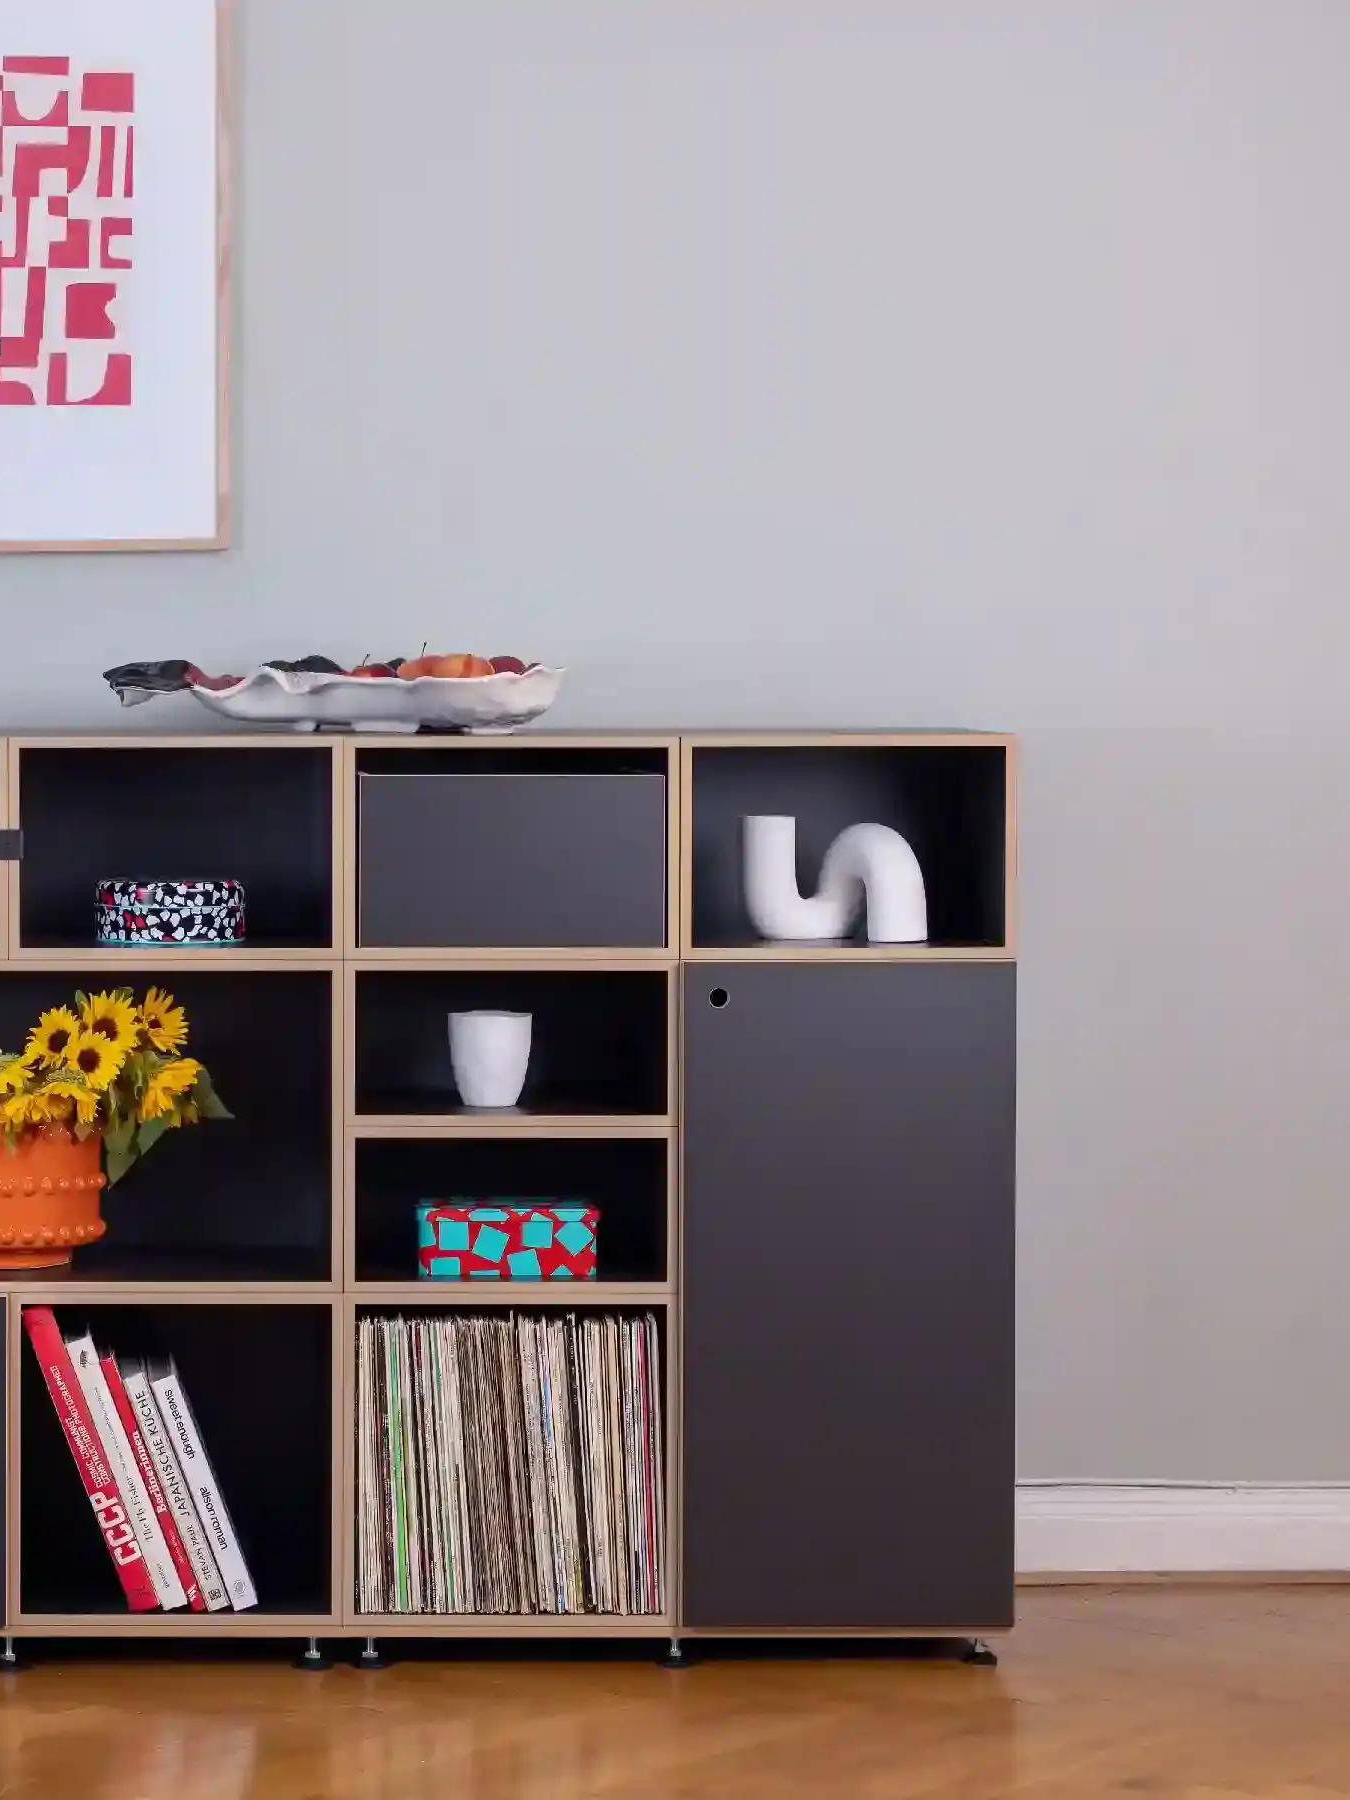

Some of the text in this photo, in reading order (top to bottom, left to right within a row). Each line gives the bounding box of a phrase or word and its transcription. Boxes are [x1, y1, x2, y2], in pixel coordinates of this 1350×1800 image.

[50, 1365, 82, 1424] PHOTOGRAPHED
[135, 1391, 159, 1436] KÜCHE
[165, 1389, 196, 1459] sweet enough
[65, 1417, 103, 1488] COSMIC COMMUNIST
[78, 1425, 111, 1485] CONSTRUCTIONS
[132, 1431, 167, 1513] Berlinerinnen
[153, 1438, 190, 1516] JAPANISCHE
[89, 1491, 142, 1566] CCCP
[199, 1486, 228, 1550] alison roman
